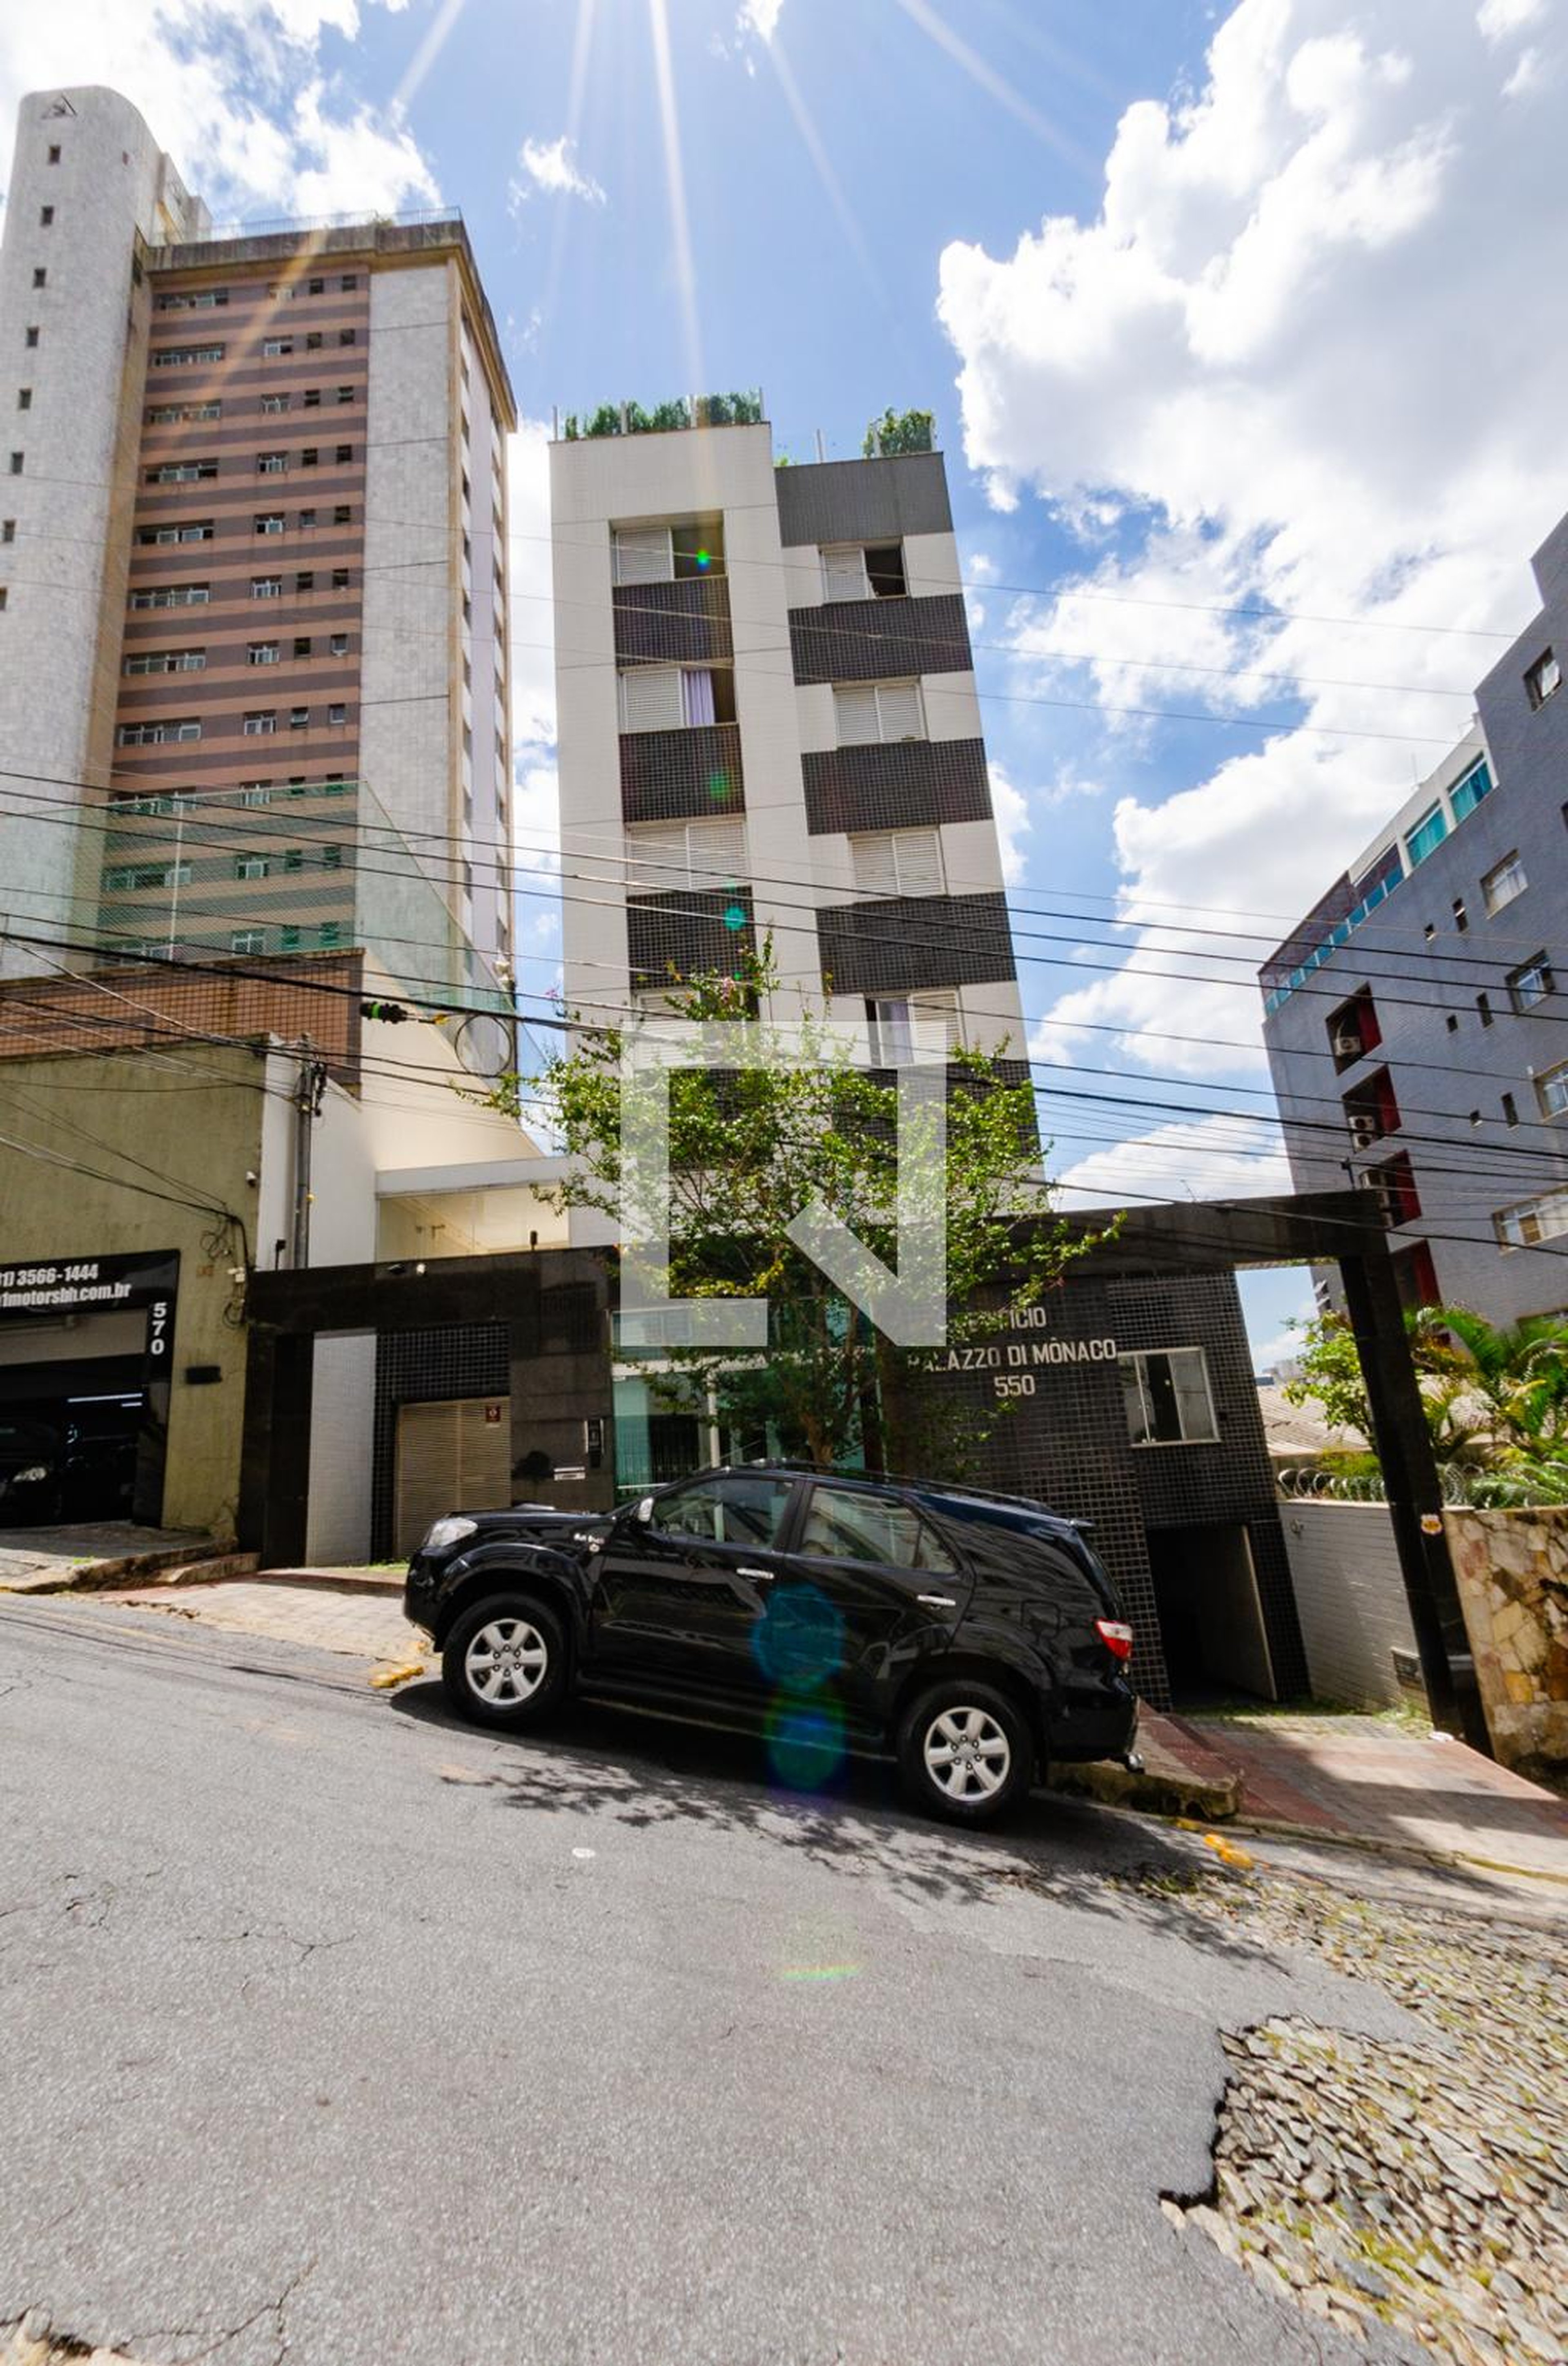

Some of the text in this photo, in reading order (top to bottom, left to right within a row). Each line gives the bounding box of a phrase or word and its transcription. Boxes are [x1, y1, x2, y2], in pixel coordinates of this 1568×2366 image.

[16, 1263, 99, 1286] 3566-1444
[0, 1282, 131, 1307] 1motorsbh.com.br
[151, 1302, 167, 1355] 570
[1007, 1344, 1027, 1366] DI
[1032, 1337, 1116, 1364] MÔNACO
[994, 1374, 1036, 1397] 550
